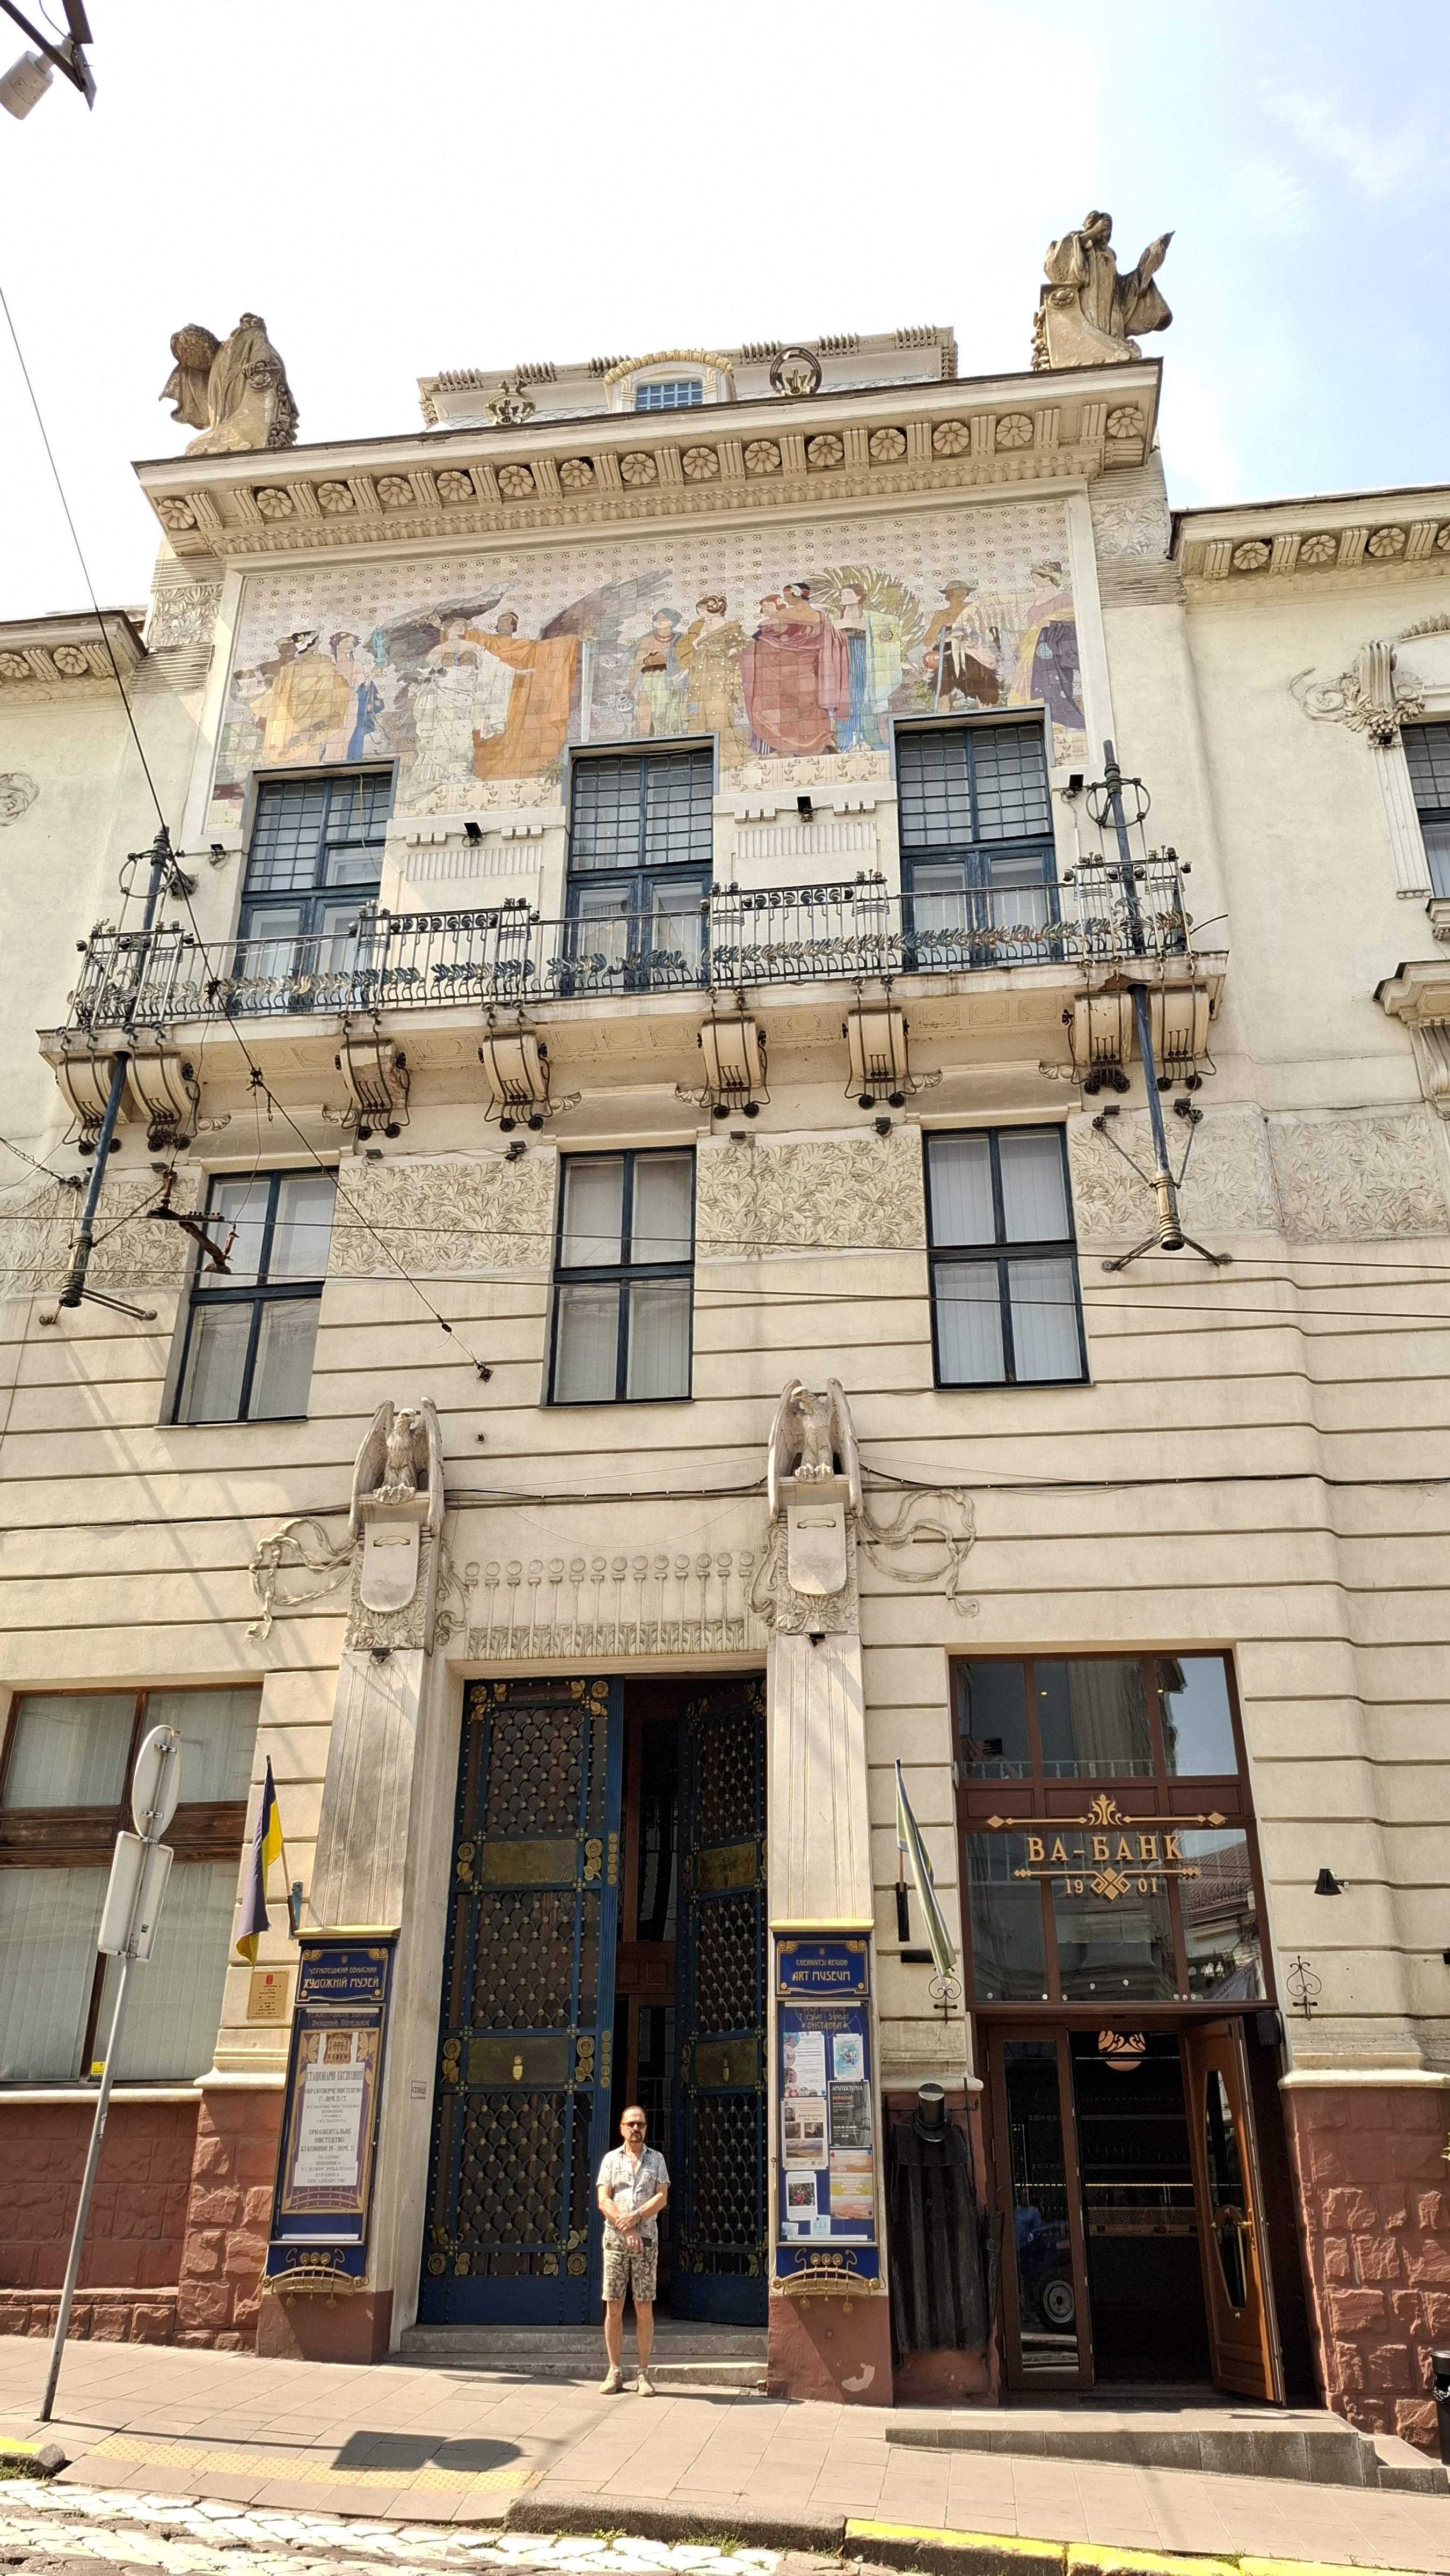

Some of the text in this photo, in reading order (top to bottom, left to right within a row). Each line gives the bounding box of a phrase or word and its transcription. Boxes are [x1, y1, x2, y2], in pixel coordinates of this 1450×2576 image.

[1026, 1835, 1185, 1862] ВА-БАНК
[1065, 1878, 1158, 1895] 19 01
[303, 1976, 379, 1989] ХУДОЖНІЙ МУЗЕЙ
[792, 1971, 850, 1981] ART MUSEUM
